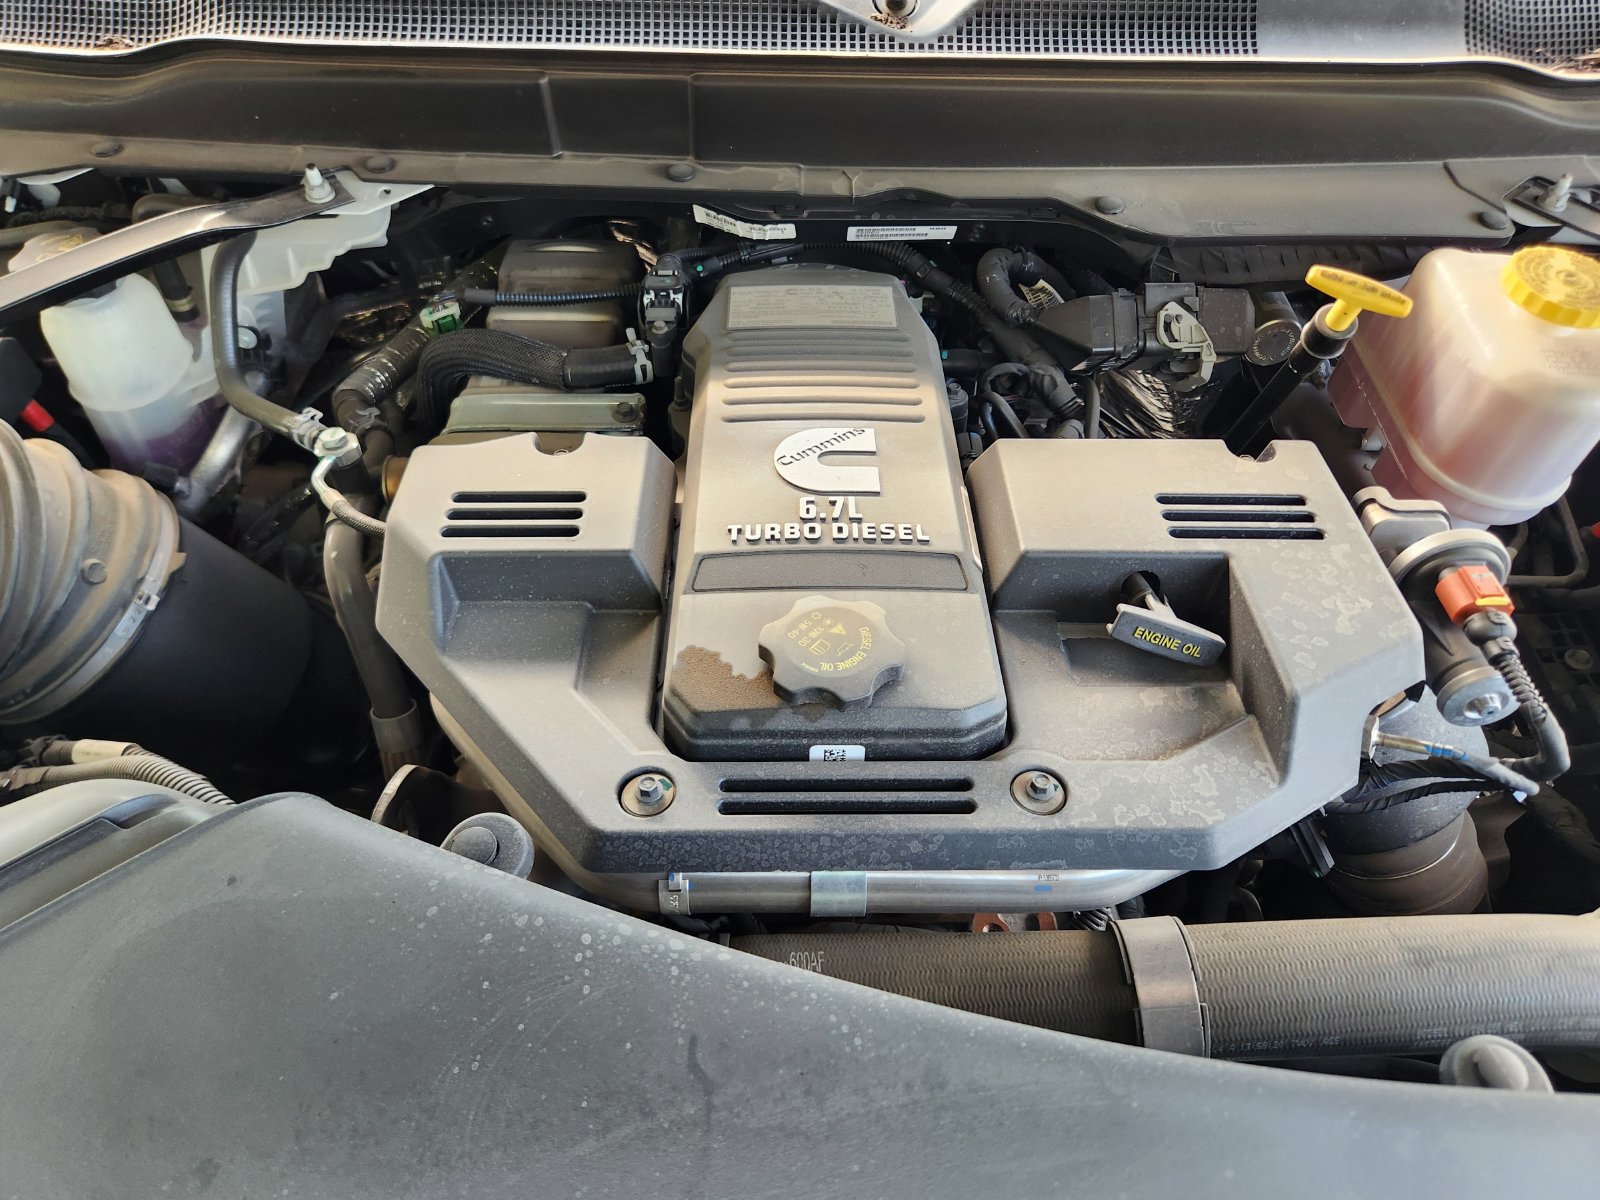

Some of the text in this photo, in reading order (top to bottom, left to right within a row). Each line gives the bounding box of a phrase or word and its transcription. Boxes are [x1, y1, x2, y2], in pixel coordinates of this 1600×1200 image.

[776, 428, 866, 466] Cummins
[799, 496, 863, 522] 6.7L
[727, 522, 930, 543] TURBO DIESEL
[859, 626, 872, 652] DIESEL
[1133, 626, 1201, 658] ENGINE OIL
[820, 662, 834, 671] OIL
[836, 650, 867, 672] ENGINE
